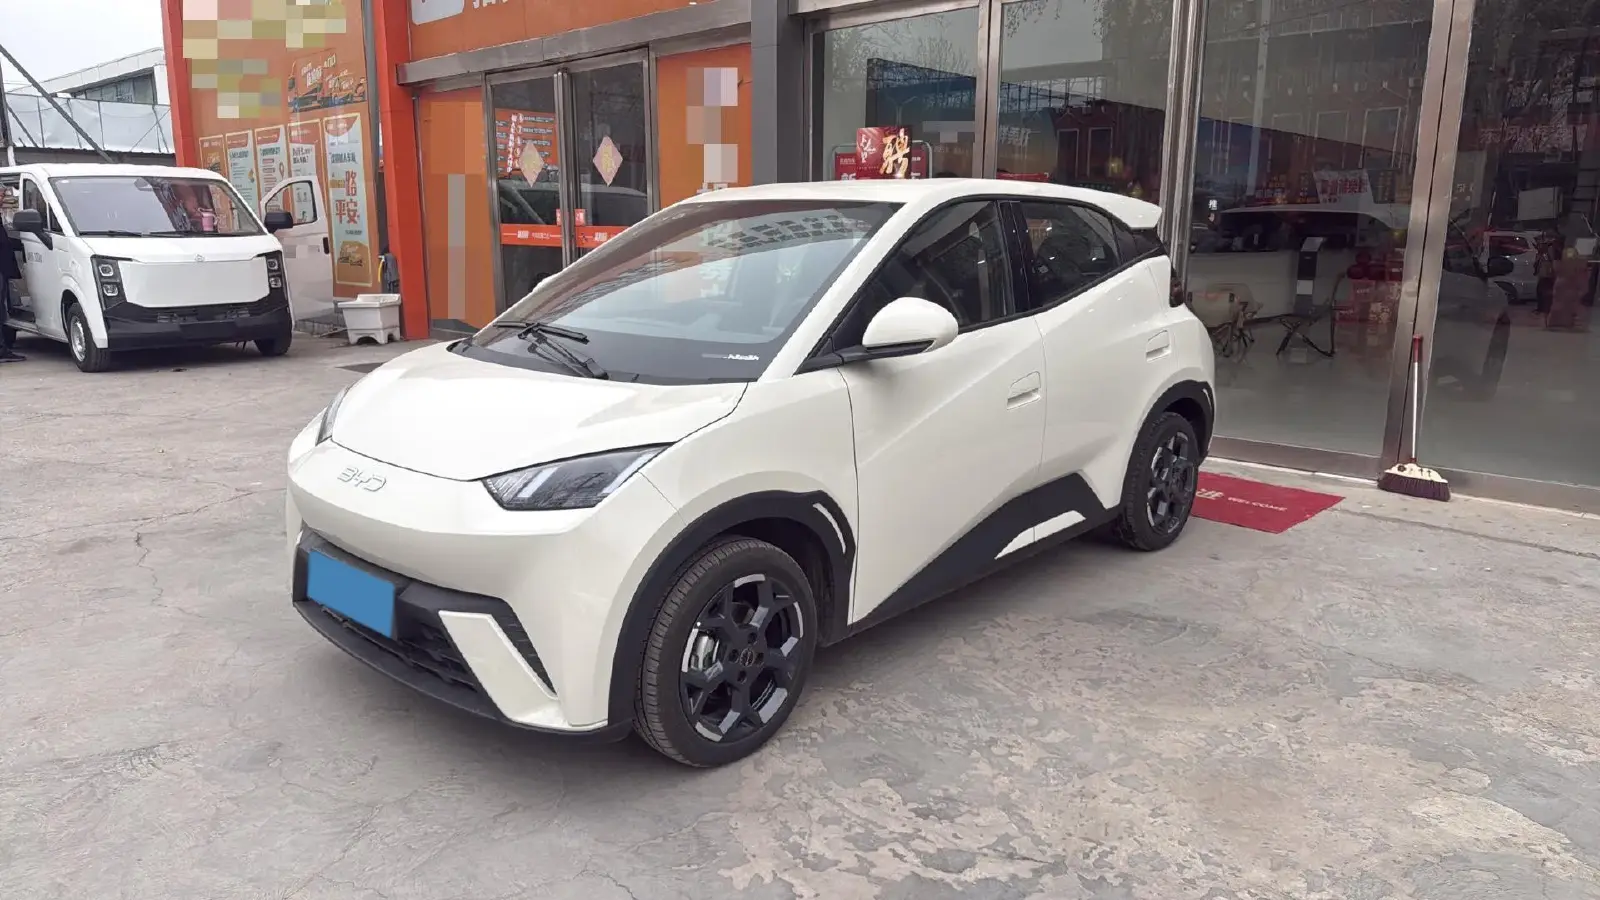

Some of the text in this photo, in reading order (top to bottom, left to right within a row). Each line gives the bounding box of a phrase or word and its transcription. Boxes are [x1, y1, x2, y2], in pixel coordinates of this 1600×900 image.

[336, 199, 358, 225] 平安
[336, 466, 387, 492] BYD
[1228, 497, 1288, 511] WELCOME
